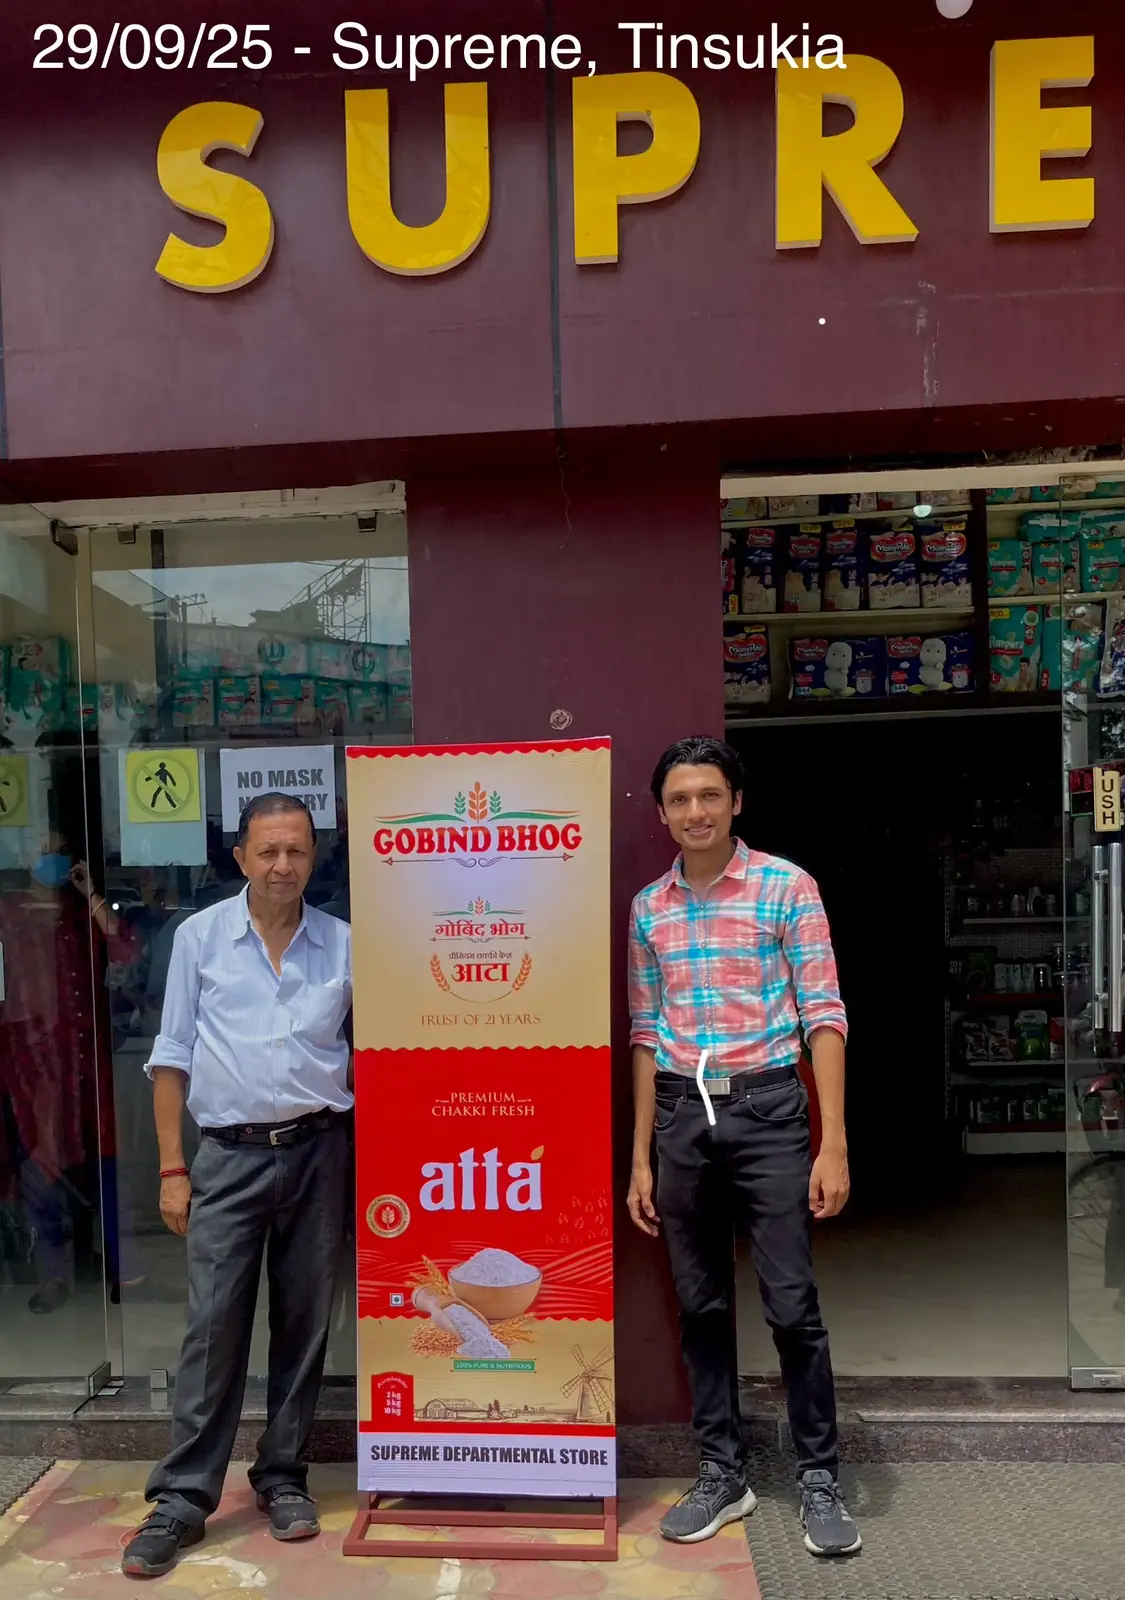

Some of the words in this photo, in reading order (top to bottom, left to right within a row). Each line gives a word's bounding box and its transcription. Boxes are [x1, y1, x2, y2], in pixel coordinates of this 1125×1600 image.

[155, 35, 1096, 293] SUPRE
[237, 771, 263, 789] NO
[267, 769, 324, 788] MASK
[373, 826, 492, 855] GOBIND
[496, 823, 582, 852] BHOG
[435, 919, 486, 936] गोबिंद
[490, 919, 526, 935] भोग
[451, 963, 510, 982] आटा
[421, 1014, 459, 1026] TRUST
[463, 1014, 481, 1025] OF
[485, 1014, 495, 1025] 21
[498, 1013, 541, 1025] YEARS
[450, 1092, 515, 1103] PREMIUM
[431, 1106, 486, 1116] CHAKKI
[492, 1105, 535, 1116] FRESH
[419, 1145, 545, 1211] atta
[392, 1391, 401, 1400] kg
[392, 1399, 401, 1408] kg
[392, 1407, 401, 1416] kg
[371, 1445, 440, 1461] SUPREME
[443, 1446, 557, 1464] DEPARTMENTAL
[559, 1449, 608, 1465] STORE
